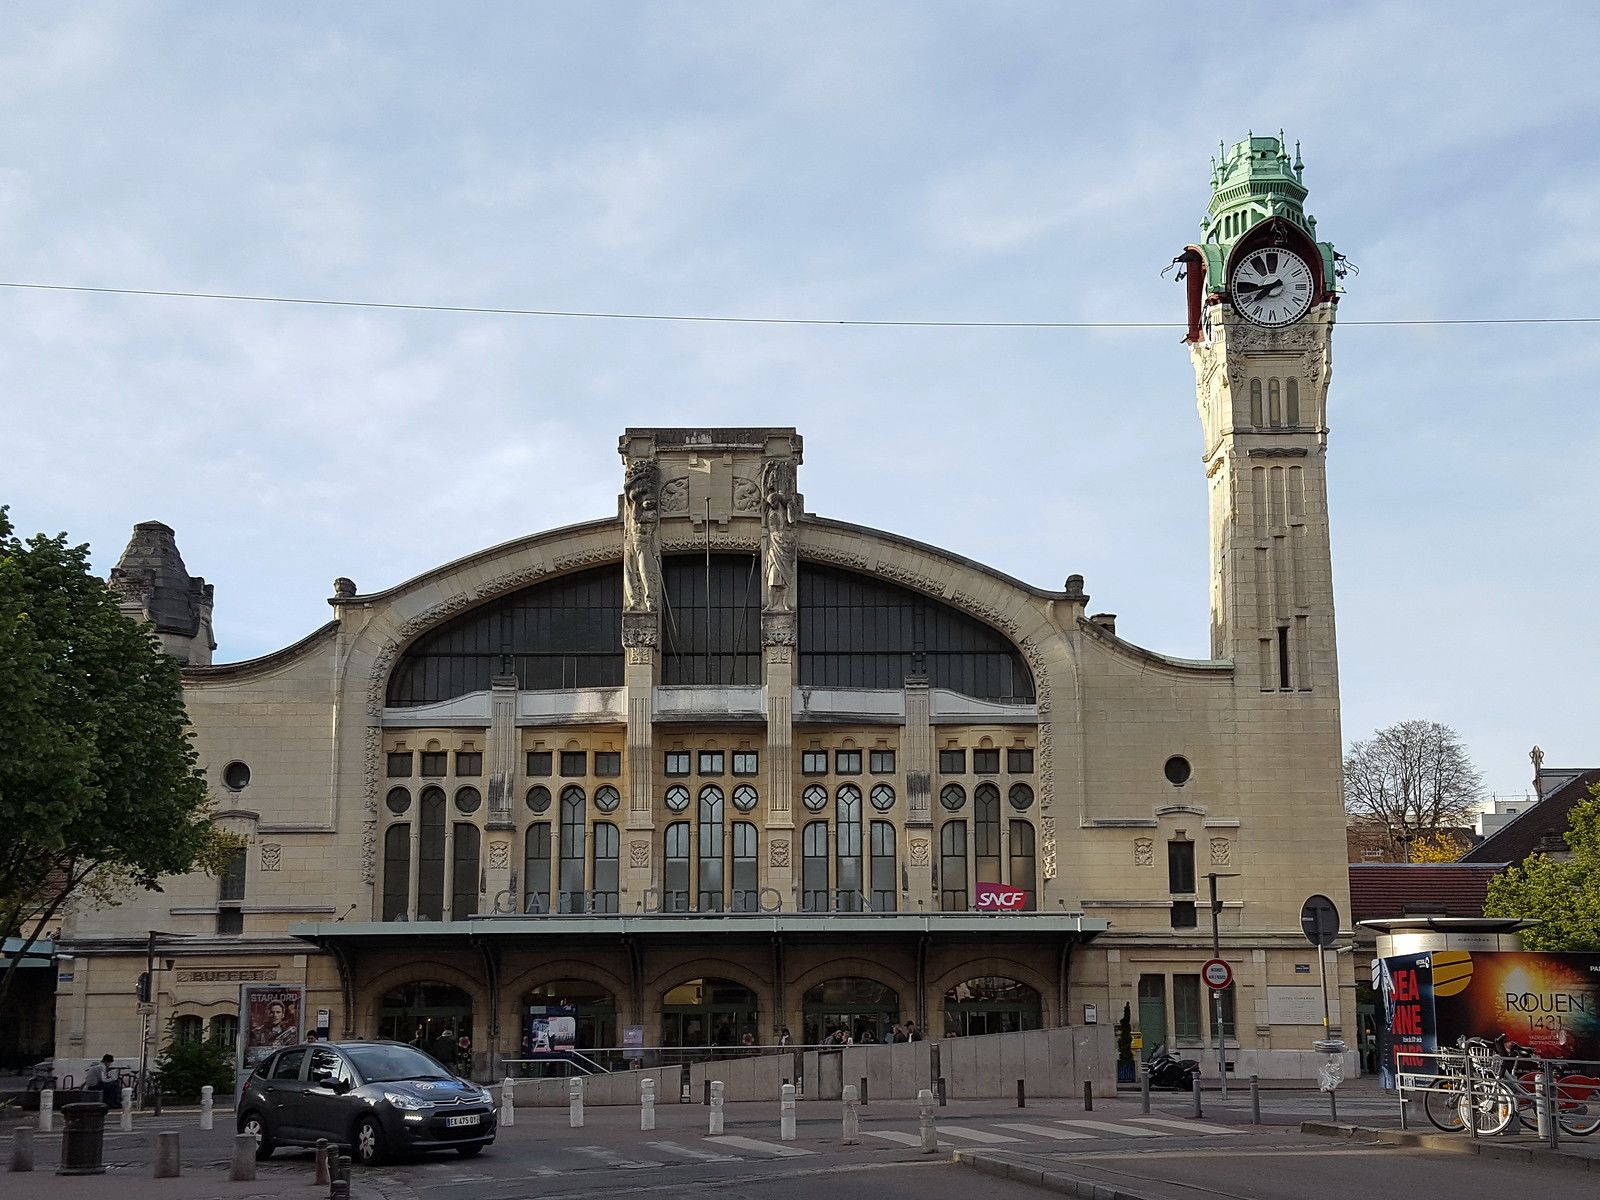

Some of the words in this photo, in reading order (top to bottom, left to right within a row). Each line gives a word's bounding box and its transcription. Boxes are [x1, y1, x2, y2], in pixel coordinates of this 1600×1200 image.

[495, 889, 596, 913] GARE
[643, 888, 686, 913] DE
[731, 888, 874, 913] ROUEN
[978, 892, 1024, 906] SNCF
[193, 970, 264, 982] BUFFET
[1506, 992, 1584, 1012] ROUEN
[1528, 1015, 1562, 1031] 1431
